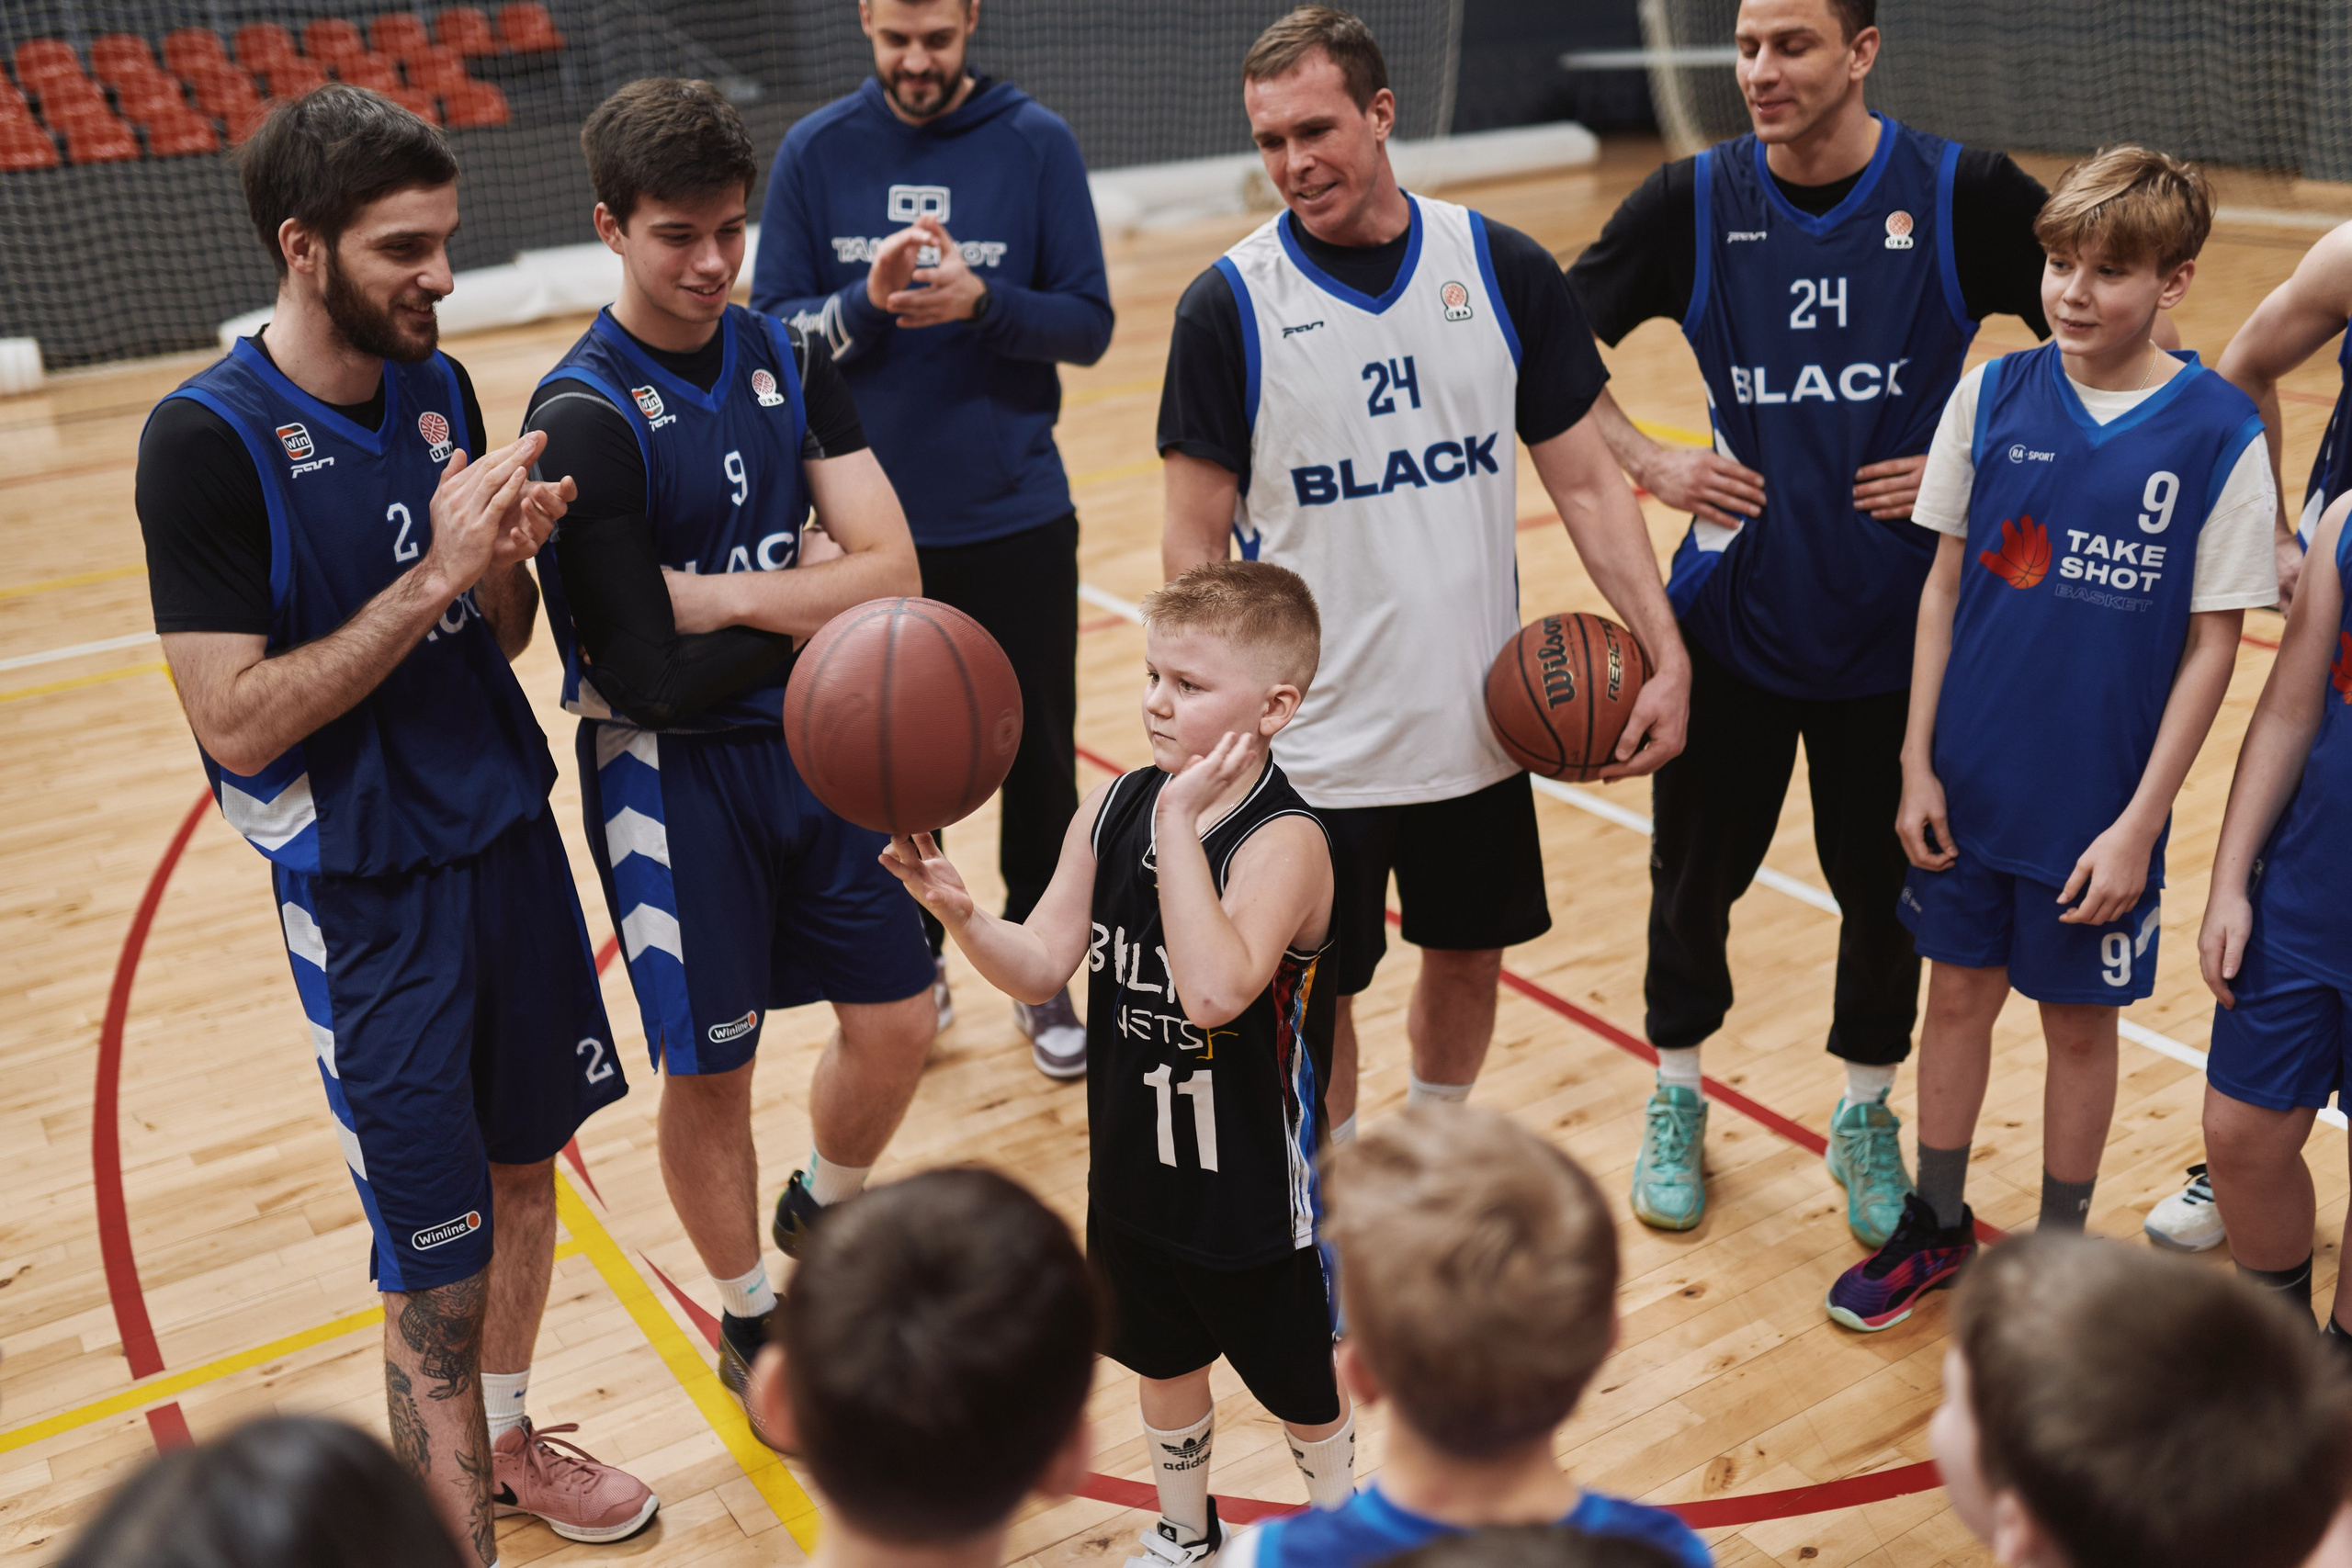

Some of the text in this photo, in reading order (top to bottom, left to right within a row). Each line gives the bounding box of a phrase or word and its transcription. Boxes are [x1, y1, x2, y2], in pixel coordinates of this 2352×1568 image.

[1790, 277, 1847, 330] 24
[1362, 355, 1421, 417] 24
[1730, 358, 1912, 404] BLACK
[284, 436, 310, 449] Win
[724, 450, 748, 506] 9
[1290, 431, 1499, 507] BLACK
[2138, 470, 2180, 534] 9
[386, 502, 419, 563] 2
[2067, 529, 2166, 568] TAKE
[2054, 583, 2154, 613] BASKET
[2059, 556, 2162, 592] SHOT
[2101, 931, 2132, 987] 9
[576, 1037, 614, 1085] 2
[1143, 1063, 1218, 1173] 11
[417, 1223, 466, 1246] Winline
[1163, 1449, 1212, 1472] adida
